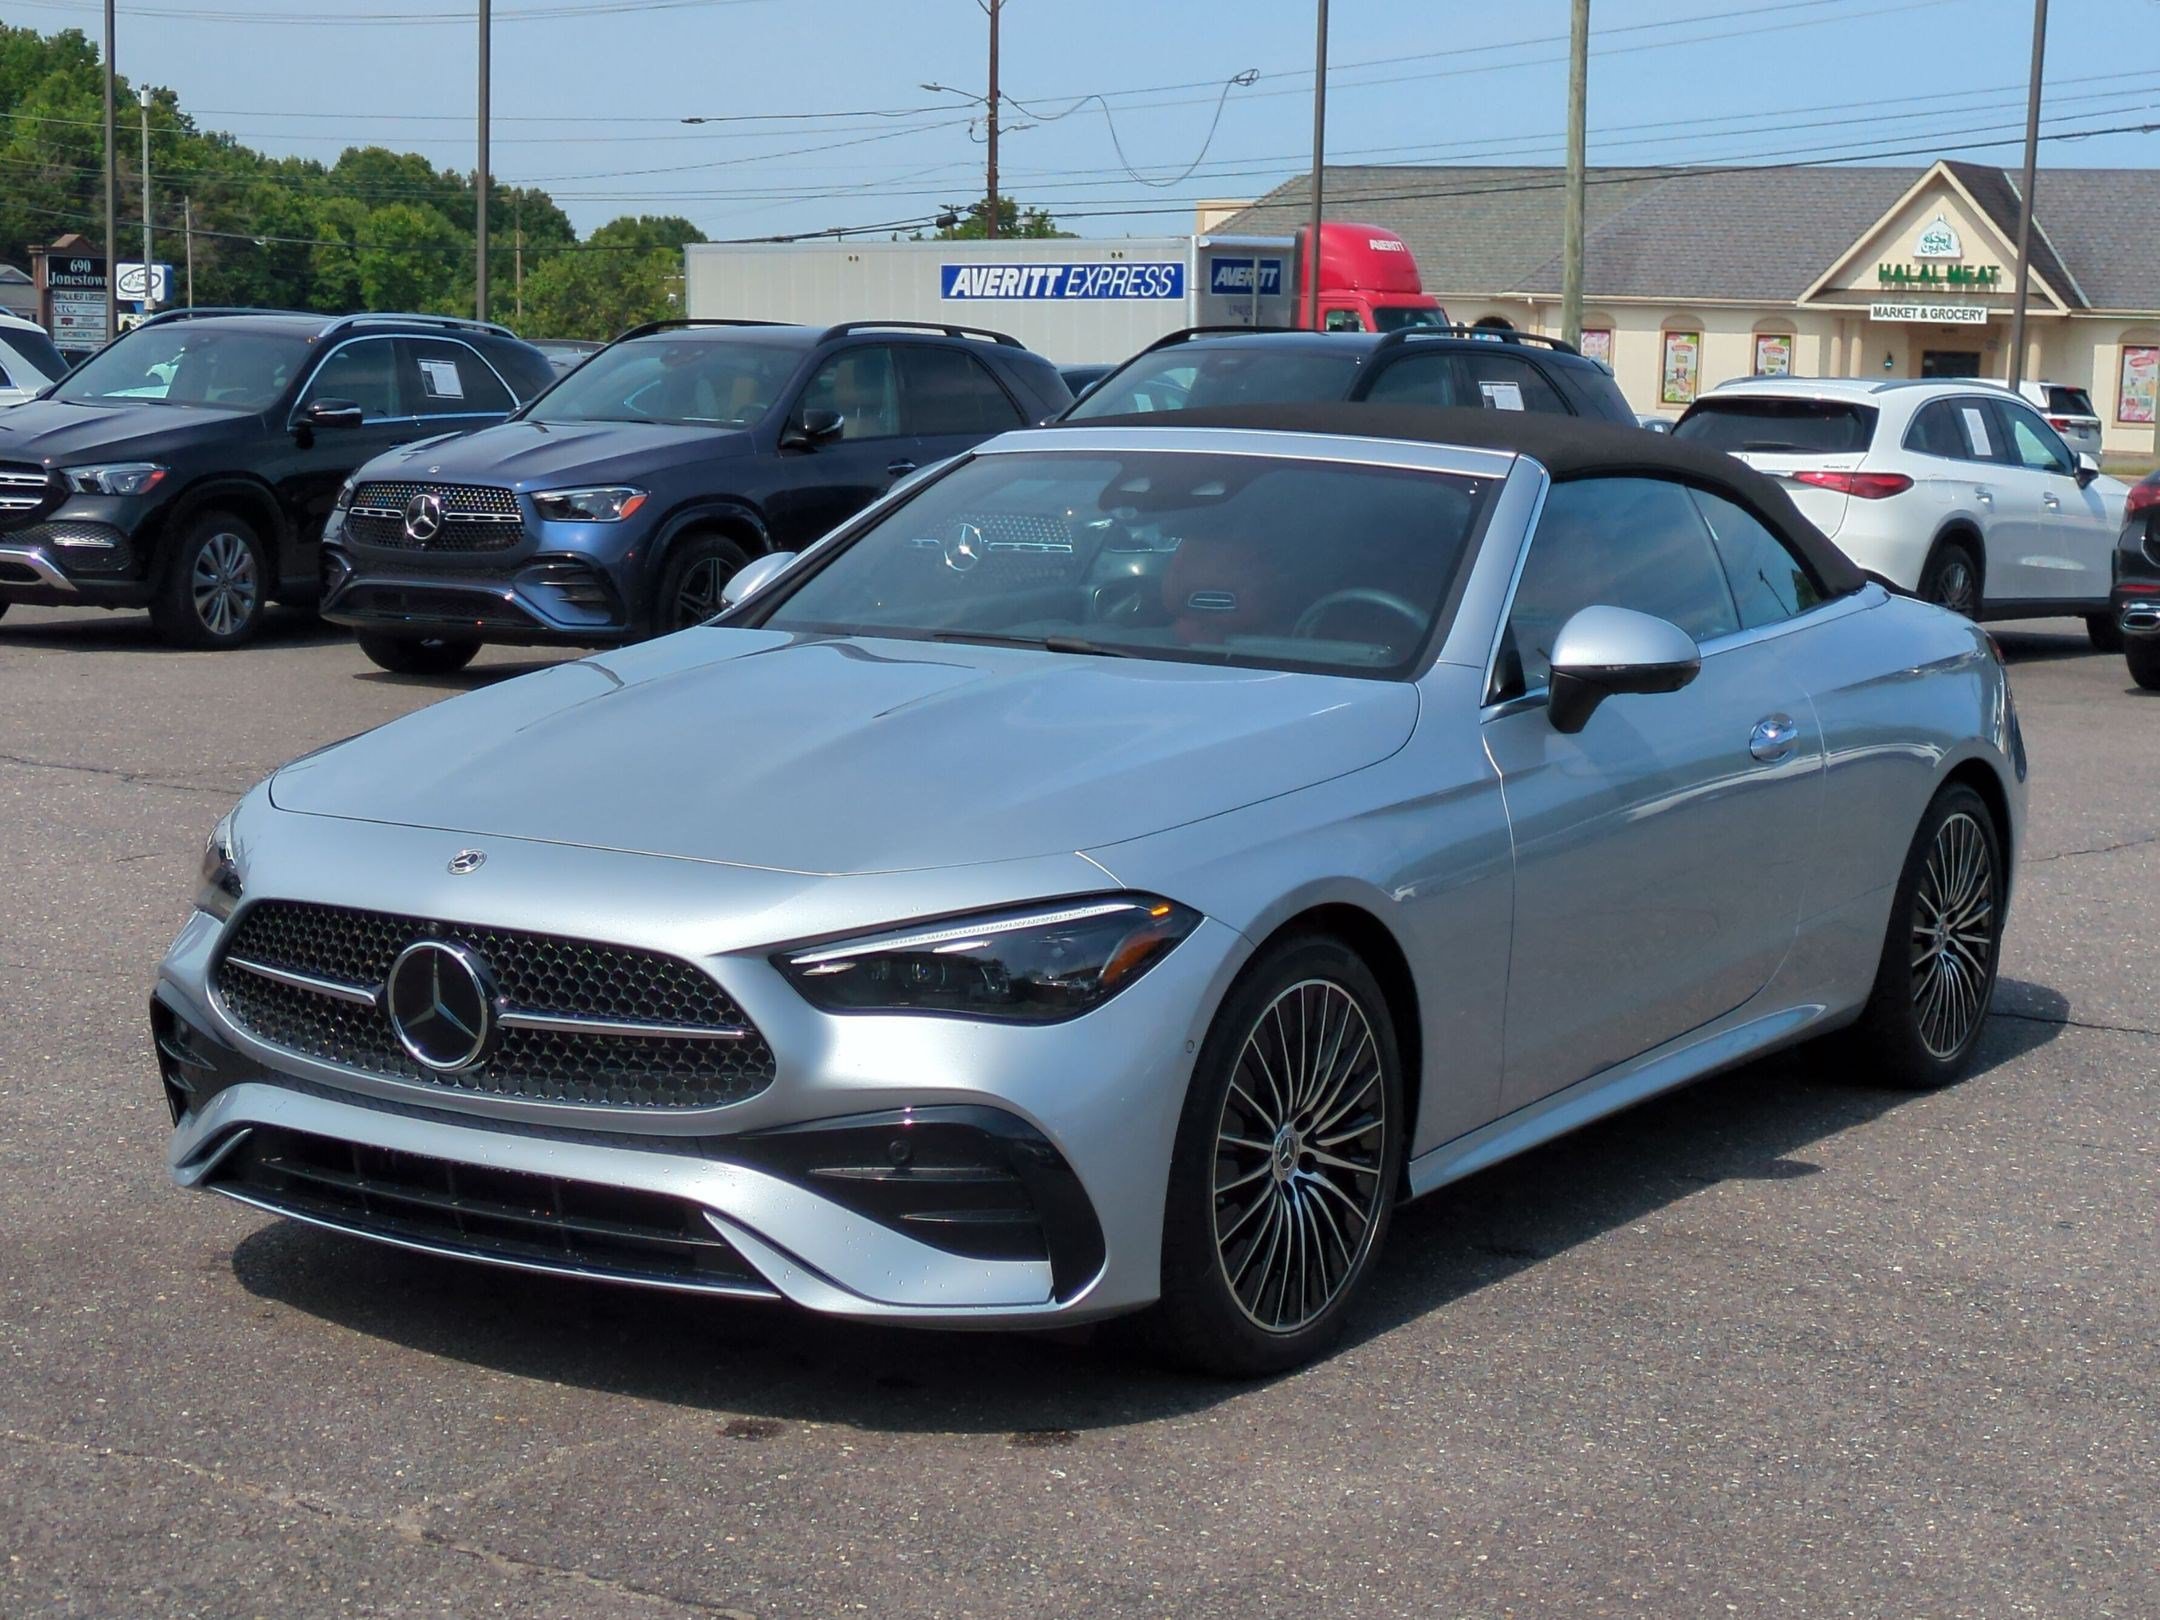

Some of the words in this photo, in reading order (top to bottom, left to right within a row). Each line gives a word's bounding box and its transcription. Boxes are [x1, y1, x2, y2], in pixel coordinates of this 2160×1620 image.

[70, 259, 91, 273] 690
[1878, 263, 1944, 284] HALAL
[1947, 264, 2000, 284] MEAT
[950, 267, 1063, 297] AVERITT
[1064, 266, 1176, 297] EXPRESS
[1214, 267, 1277, 287] AVERTT
[1873, 306, 1918, 319] MARKET
[1920, 308, 1927, 319] &
[1930, 308, 1985, 321] GROCERY
